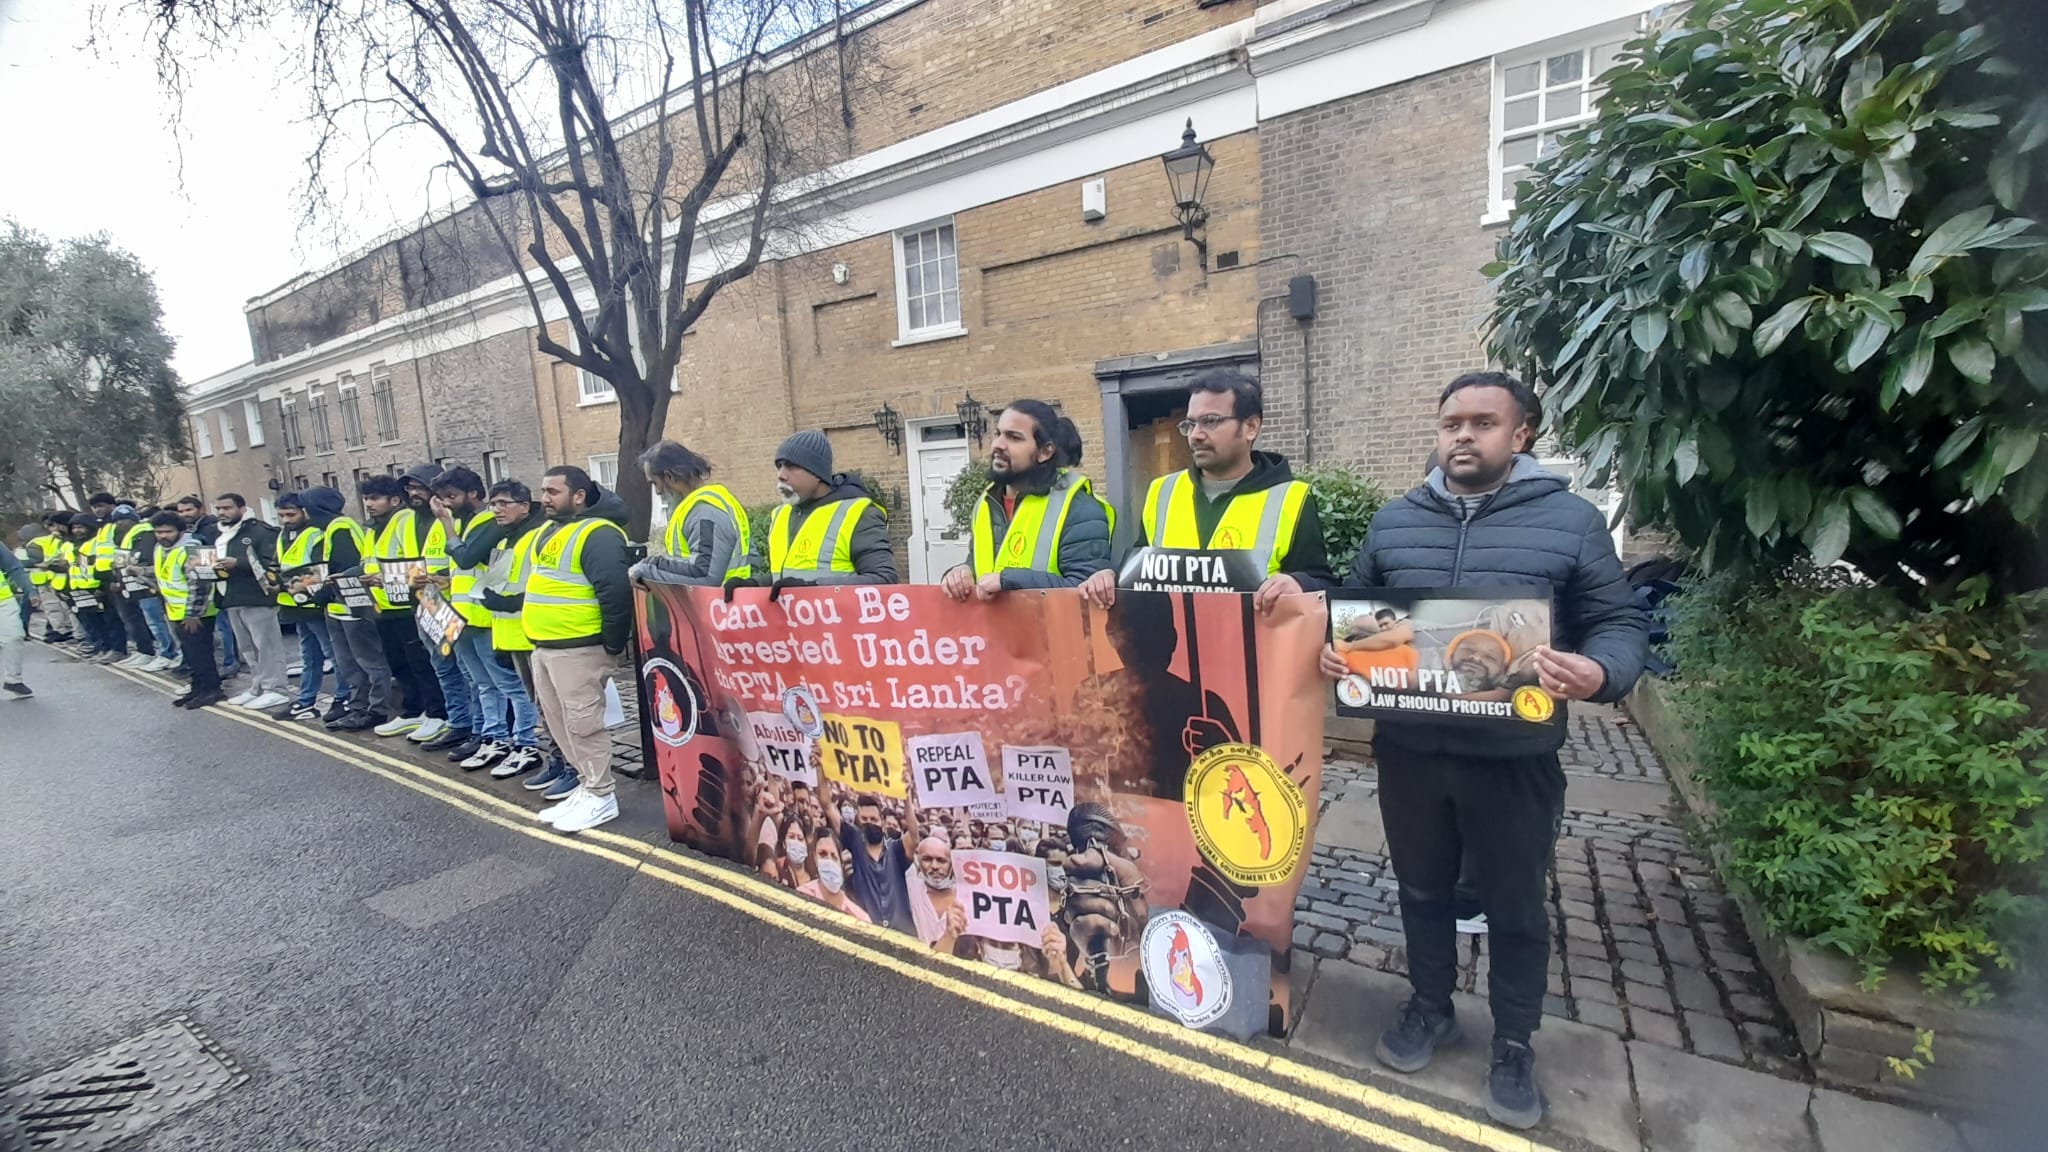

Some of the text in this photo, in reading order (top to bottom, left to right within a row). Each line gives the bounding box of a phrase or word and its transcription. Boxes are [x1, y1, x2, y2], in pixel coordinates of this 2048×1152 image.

[1140, 554, 1228, 584] NOT PTA
[709, 587, 912, 631] Can You Be
[852, 629, 986, 668] Under
[832, 681, 880, 709] Sri
[886, 674, 1028, 710] Lanka?
[1369, 666, 1462, 694] NOT PTA
[1370, 692, 1513, 717] LAW SHOULD PROTECT
[753, 723, 805, 744] Abolish
[823, 720, 885, 753] NO TO
[765, 745, 807, 774] PTA
[834, 748, 891, 788] PTA!
[916, 744, 975, 764] REPEAL
[1017, 754, 1057, 770] PTA
[924, 765, 985, 792] PTA
[1008, 772, 1071, 785] KILLER LAW
[1018, 786, 1068, 810] PTA
[962, 860, 1037, 892] STOP
[1219, 861, 1268, 882] GOVERNMENT
[972, 891, 1037, 931] PTA
